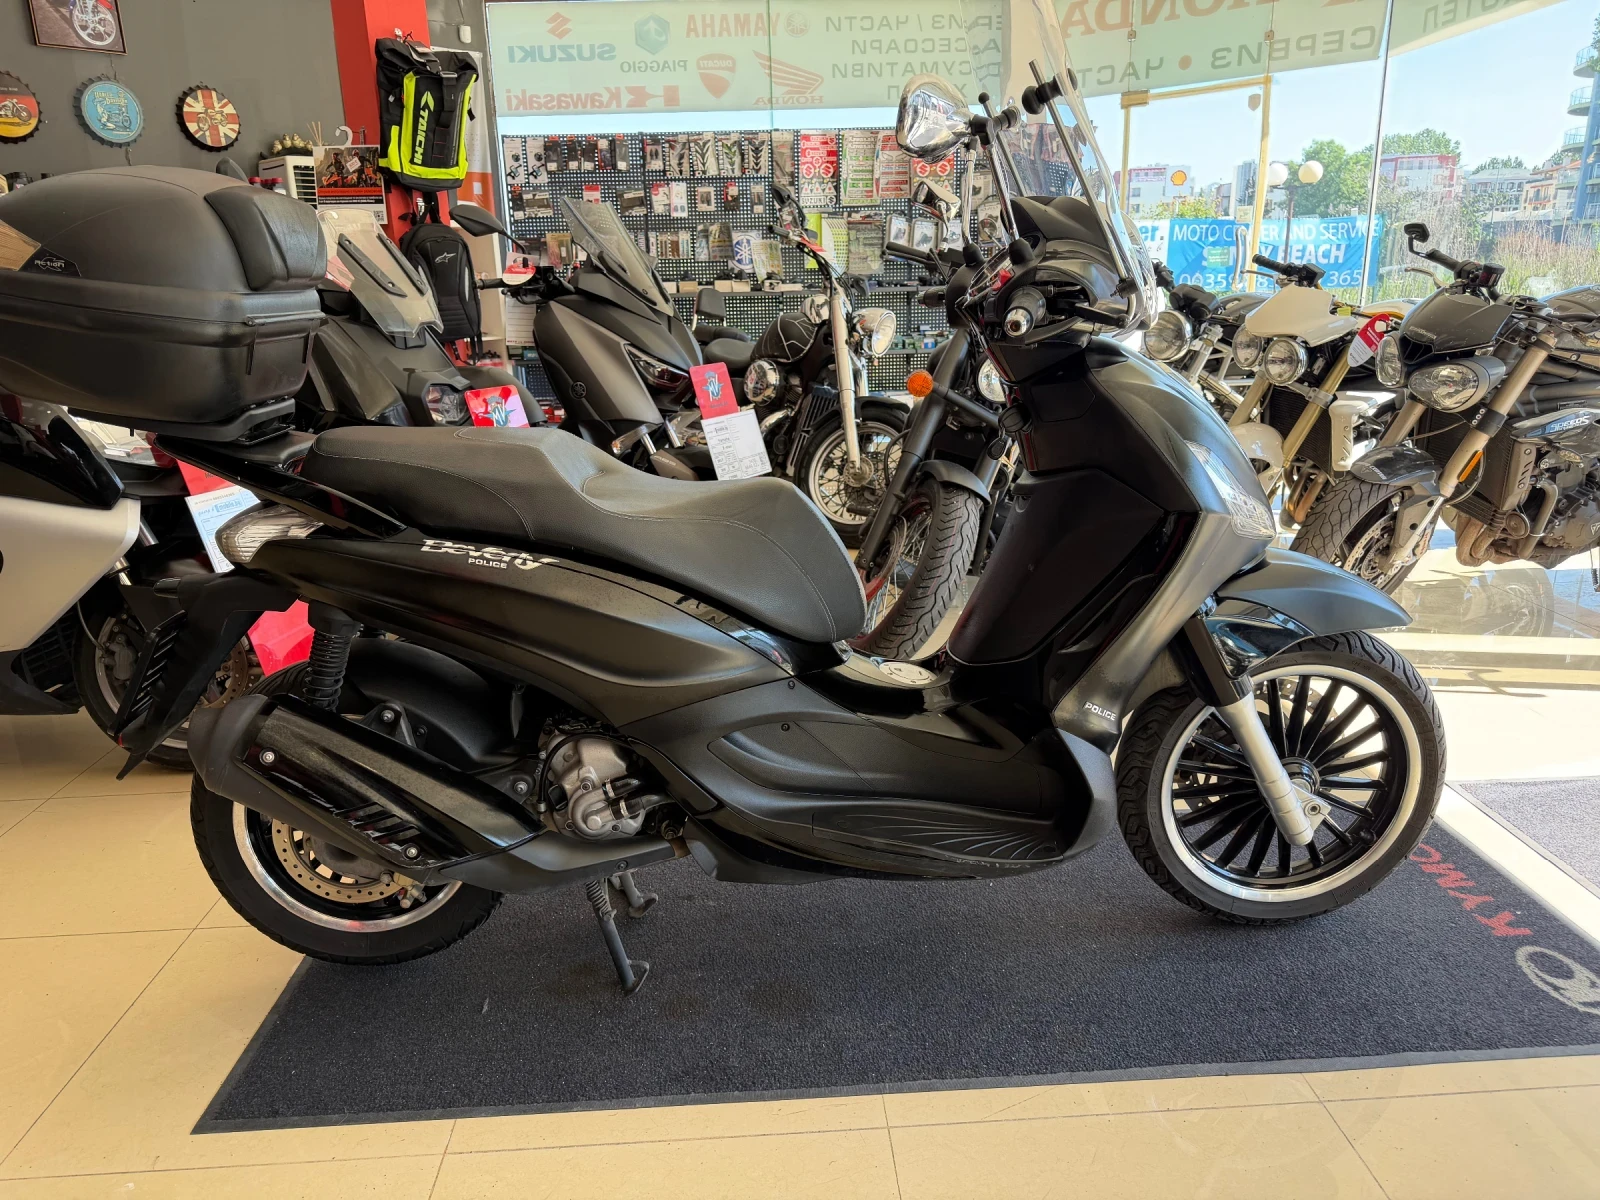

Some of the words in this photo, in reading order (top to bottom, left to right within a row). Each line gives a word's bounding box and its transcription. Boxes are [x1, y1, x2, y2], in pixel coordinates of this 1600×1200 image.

[413, 108, 429, 165] TAICHI
[1173, 224, 1220, 241] MOTO
[468, 557, 508, 569] POLICE
[1084, 701, 1117, 721] POLICE
[1409, 842, 1534, 937] KYMC
